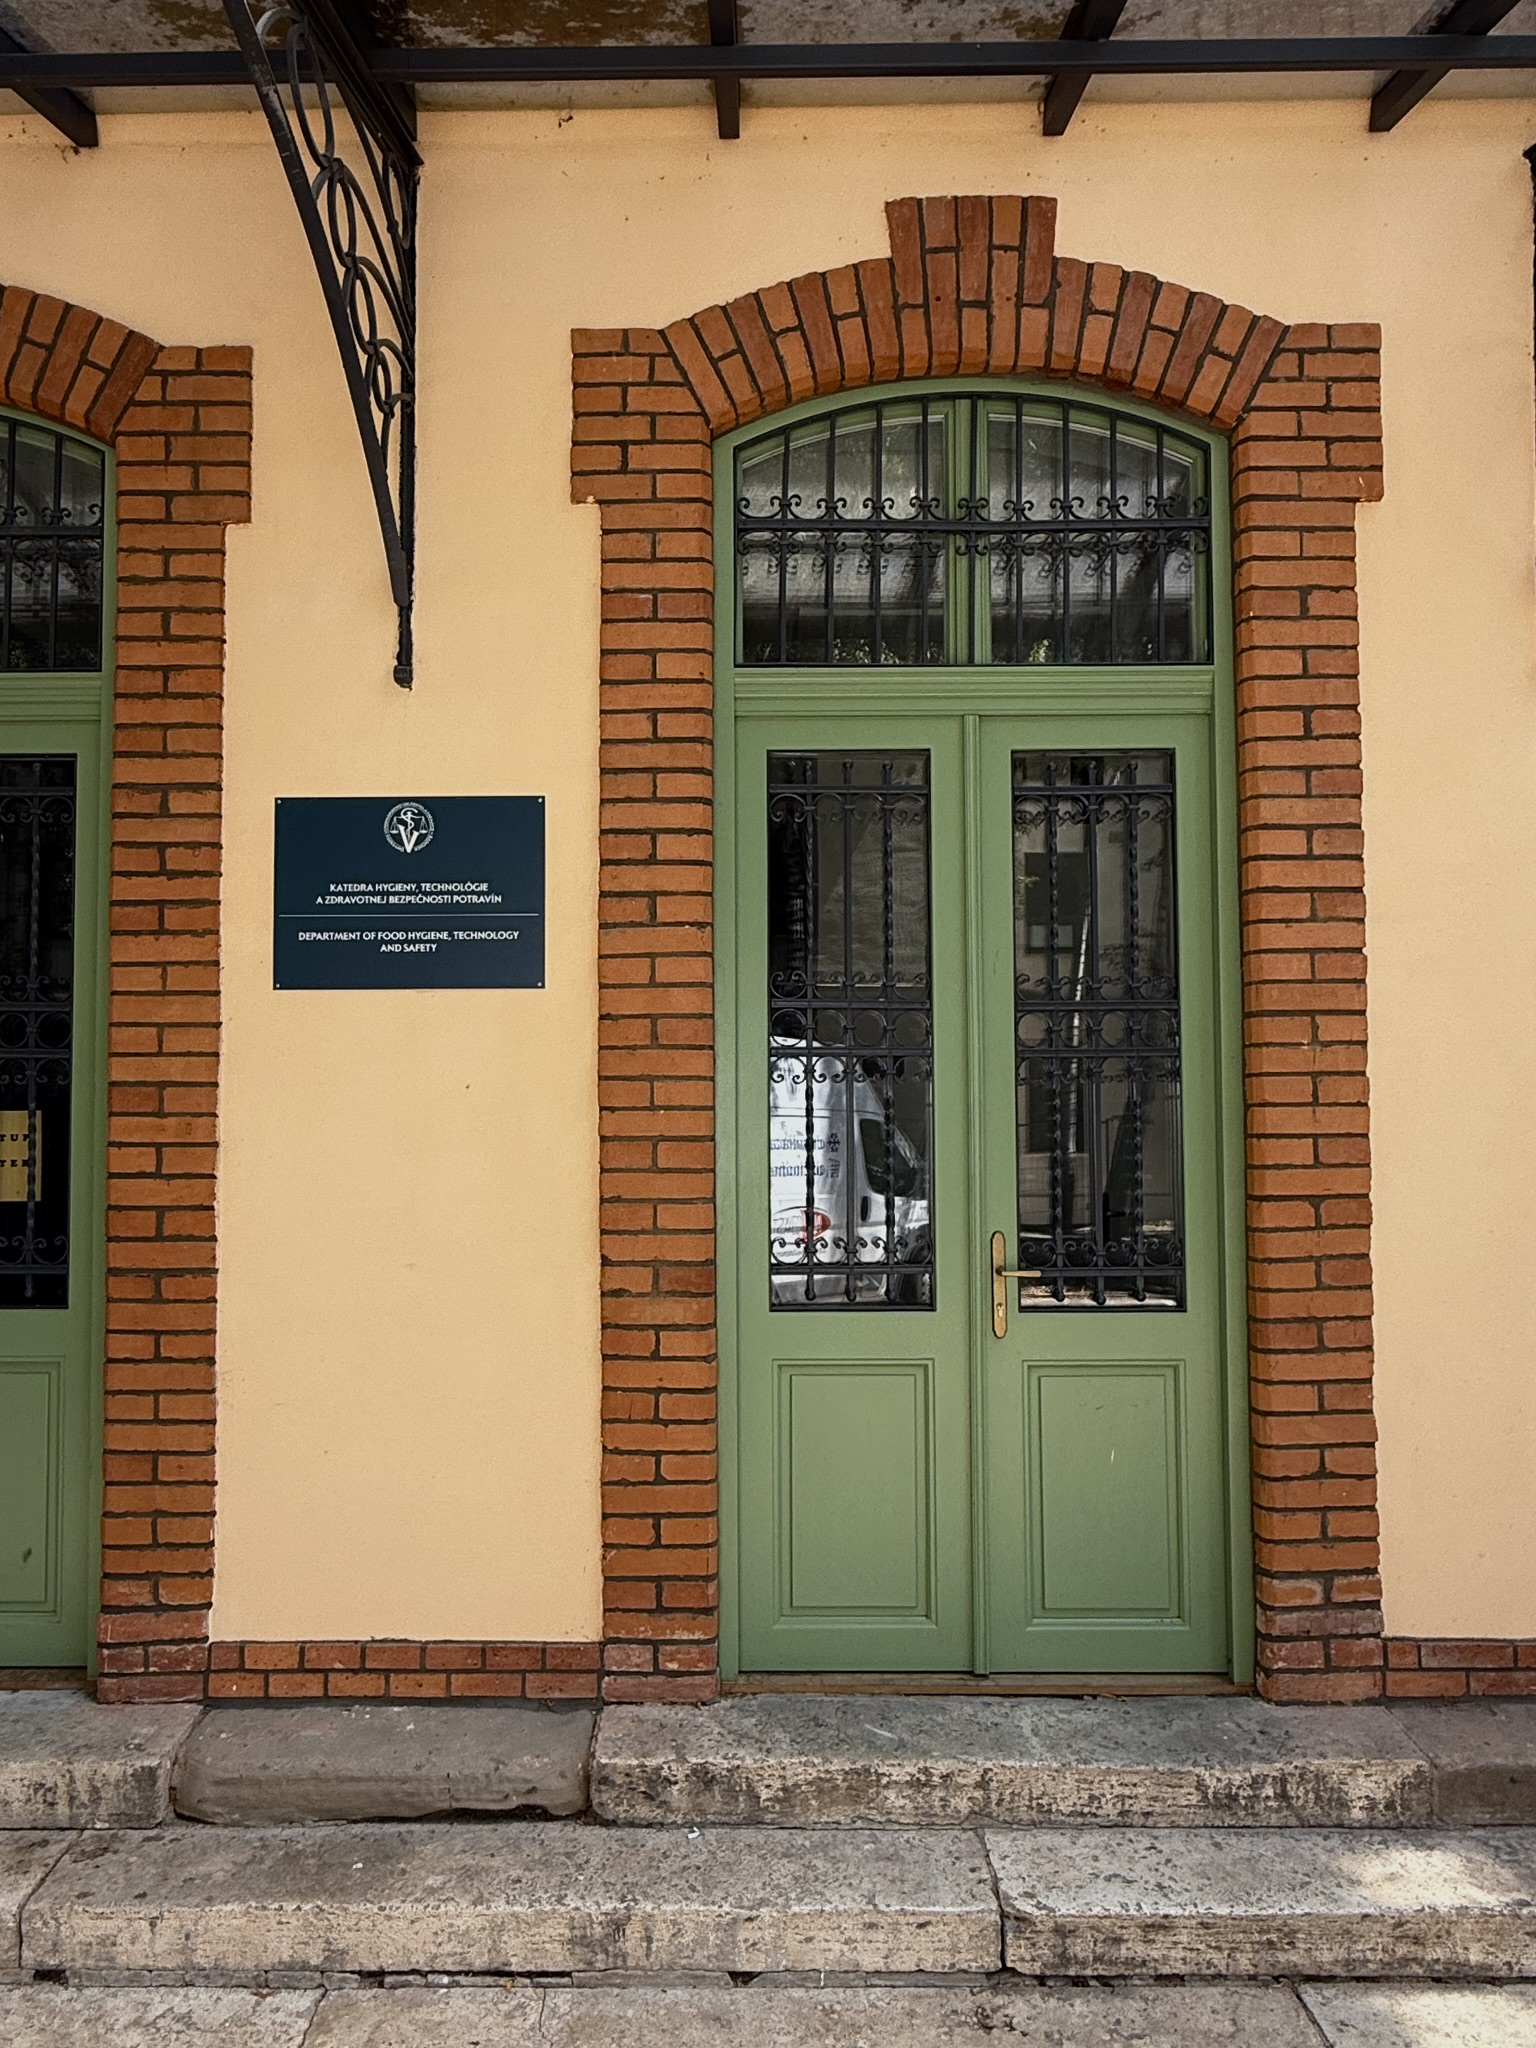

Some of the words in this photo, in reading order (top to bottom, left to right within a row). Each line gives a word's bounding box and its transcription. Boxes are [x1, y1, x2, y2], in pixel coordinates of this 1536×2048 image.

[329, 883, 374, 892] KATEDRA
[375, 883, 419, 893] HYGIENY,
[420, 881, 489, 892] TECHNOLÓGIE
[315, 896, 324, 904] A
[324, 895, 387, 905] ZDRAVOTNEJ
[388, 894, 452, 904] BEZPEČNOSTI
[453, 893, 502, 904] POTRAVÍN
[298, 931, 361, 941] DEPARTMENT
[362, 931, 376, 941] OF
[377, 931, 406, 940] FOOD
[407, 931, 452, 941] HYGIENE,
[453, 931, 520, 940] TECHNOLOGY
[380, 943, 402, 953] AND
[403, 943, 438, 952] SAFETY
